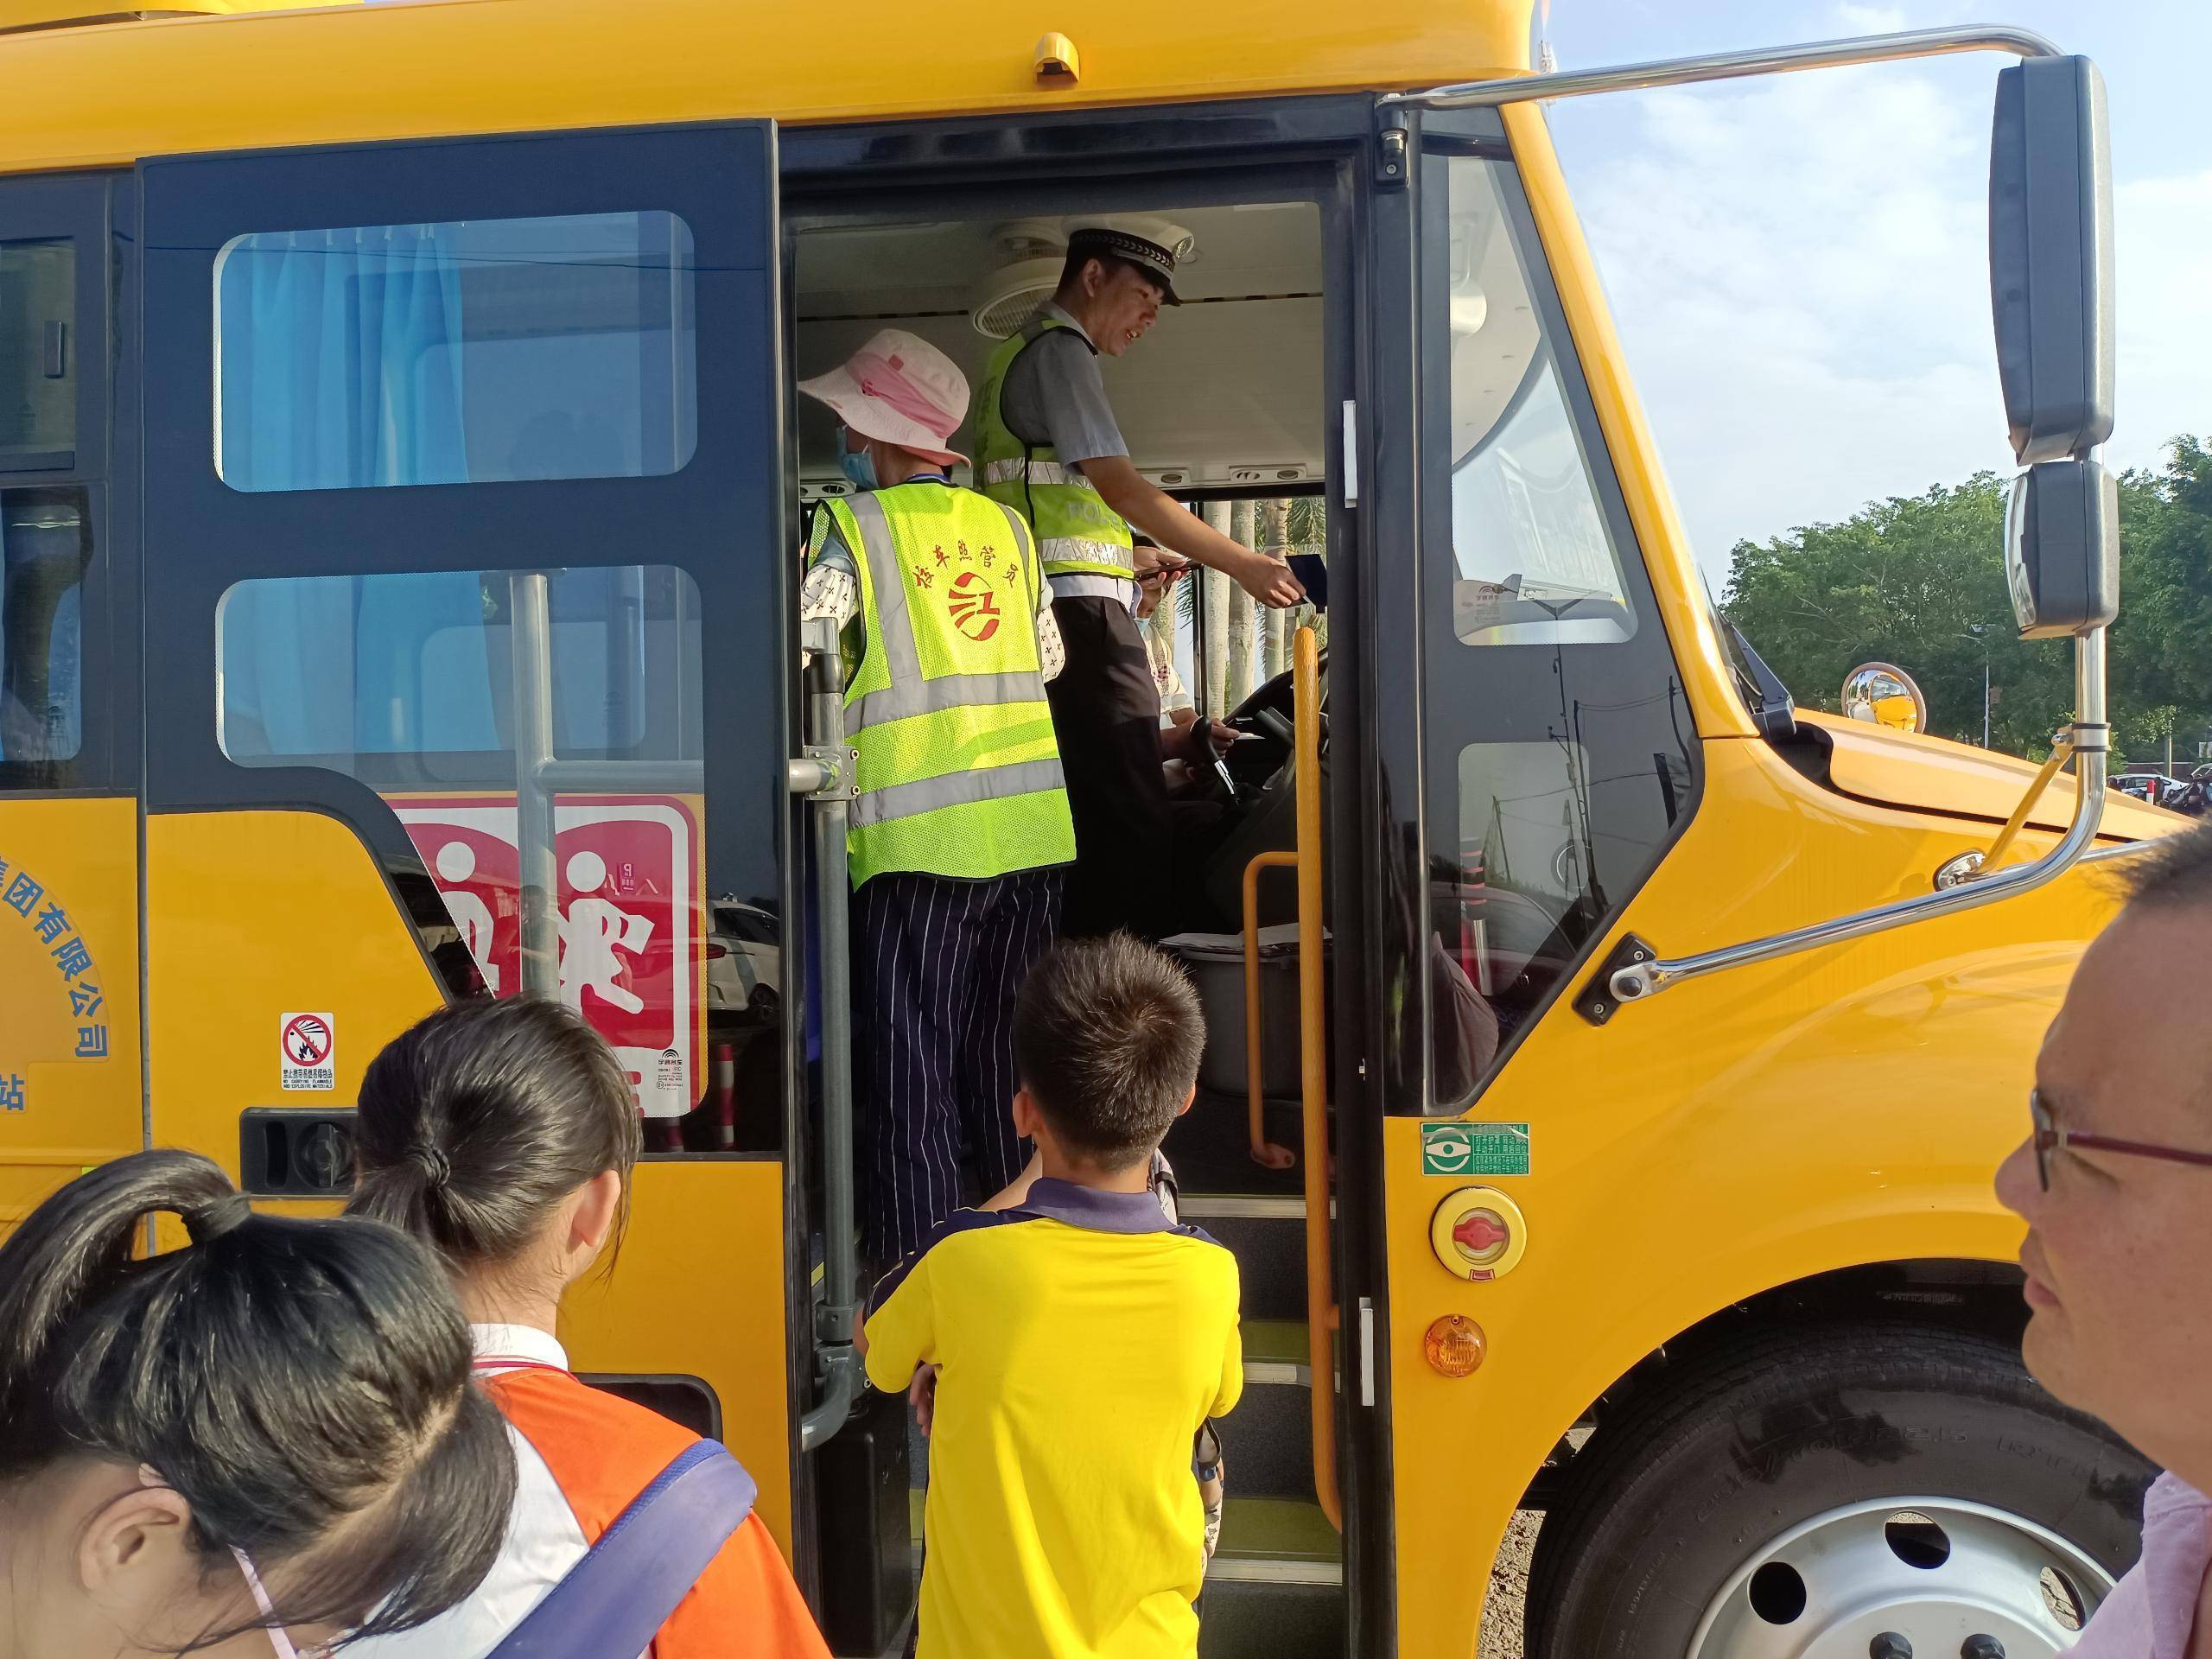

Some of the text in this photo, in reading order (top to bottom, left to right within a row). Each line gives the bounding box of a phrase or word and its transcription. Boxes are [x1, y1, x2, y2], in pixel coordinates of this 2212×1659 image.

[912, 539, 1018, 588] 校车照管员
[0, 856, 108, 1058] 团有限公司
[0, 1074, 24, 1110] 站
[283, 1069, 332, 1078] 禁止携带易燃易爆物品
